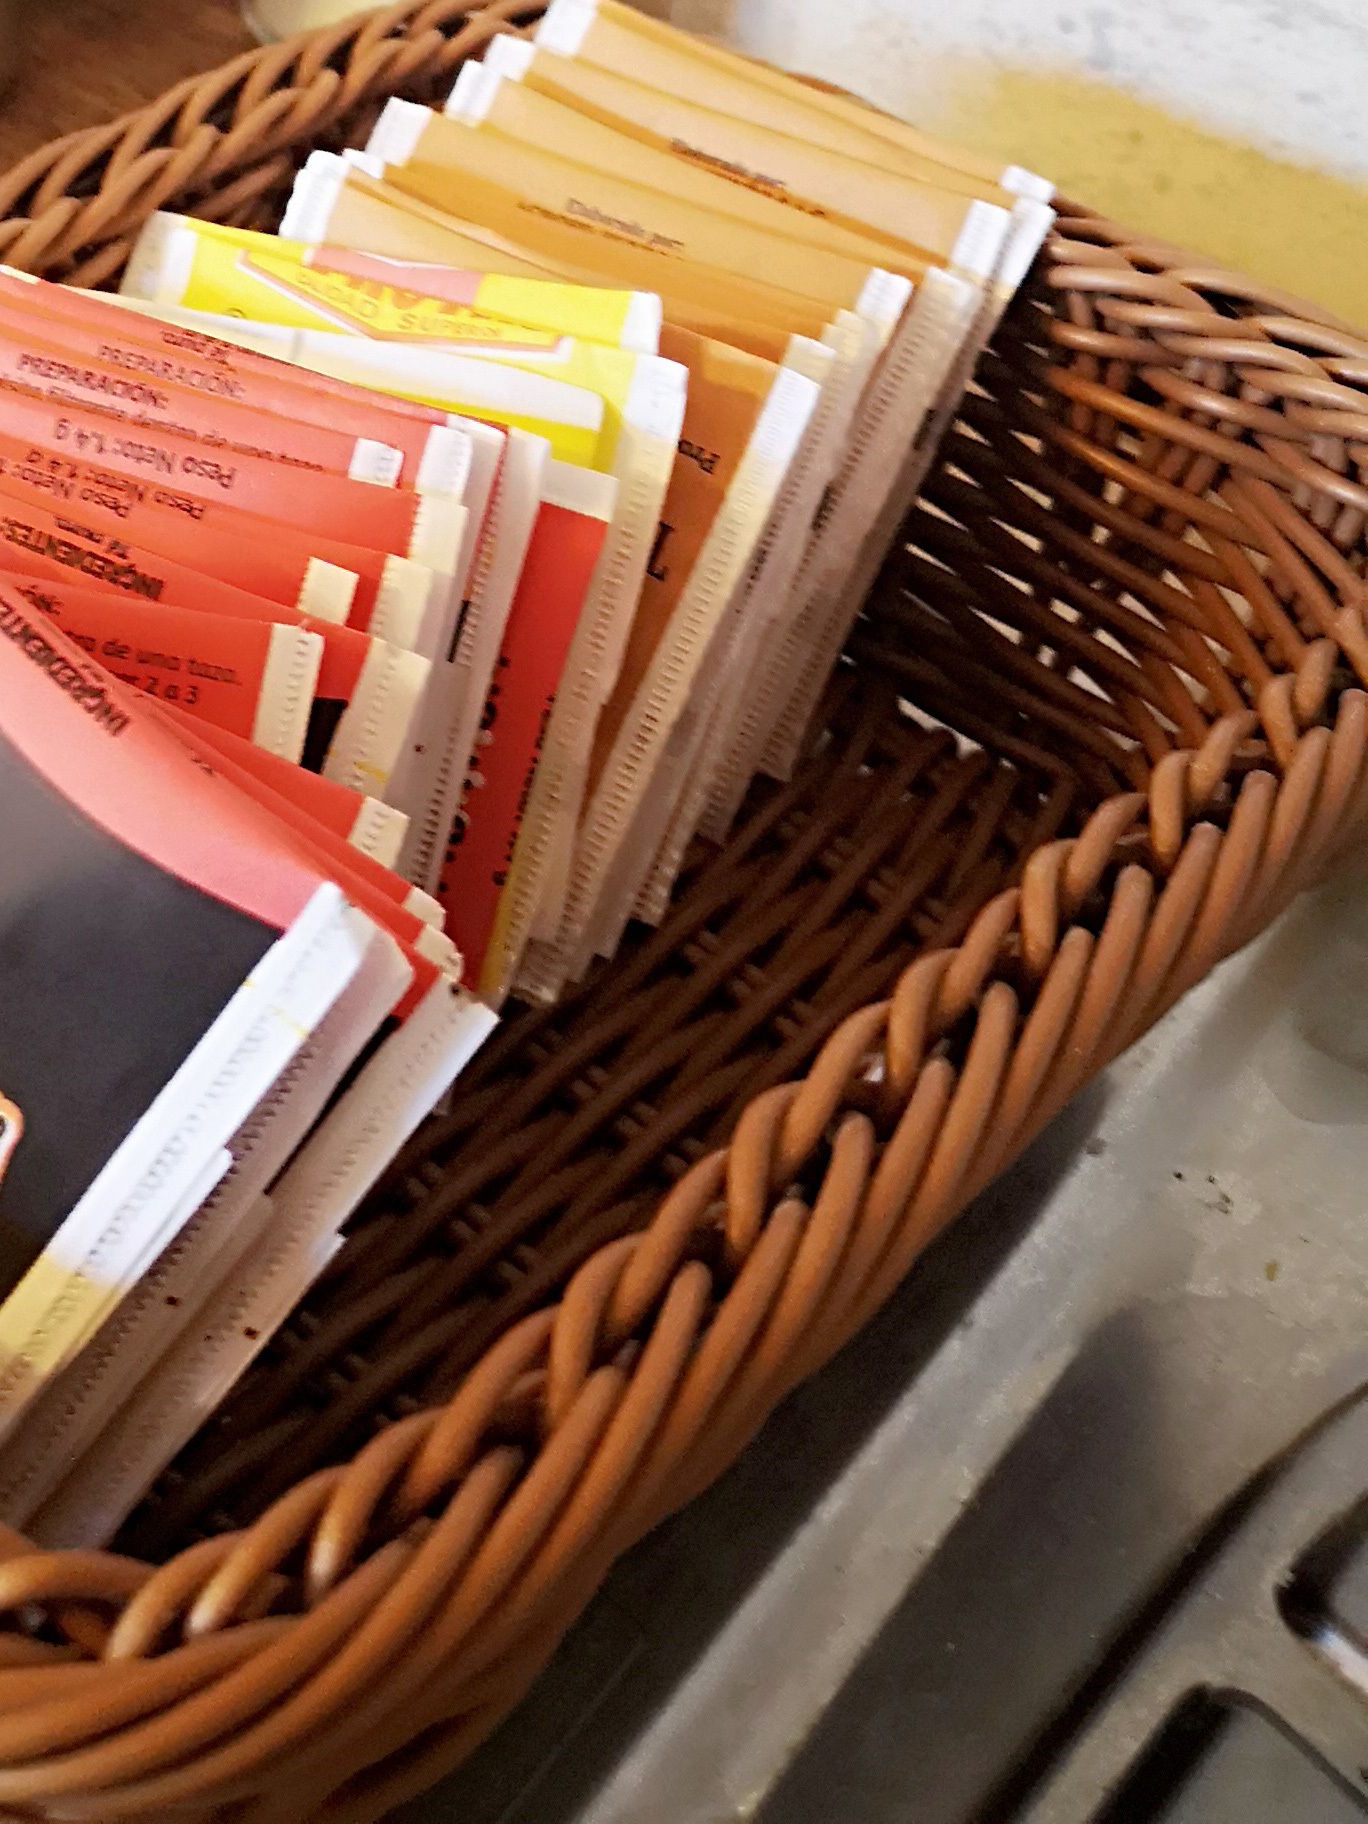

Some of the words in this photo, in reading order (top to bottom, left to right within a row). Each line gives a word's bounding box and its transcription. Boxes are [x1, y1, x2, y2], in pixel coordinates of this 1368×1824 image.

[54, 416, 71, 441] g
[114, 436, 178, 476] Neto:
[182, 454, 237, 490] Peso
[80, 487, 132, 519] Peso
[153, 489, 206, 521] Peso
